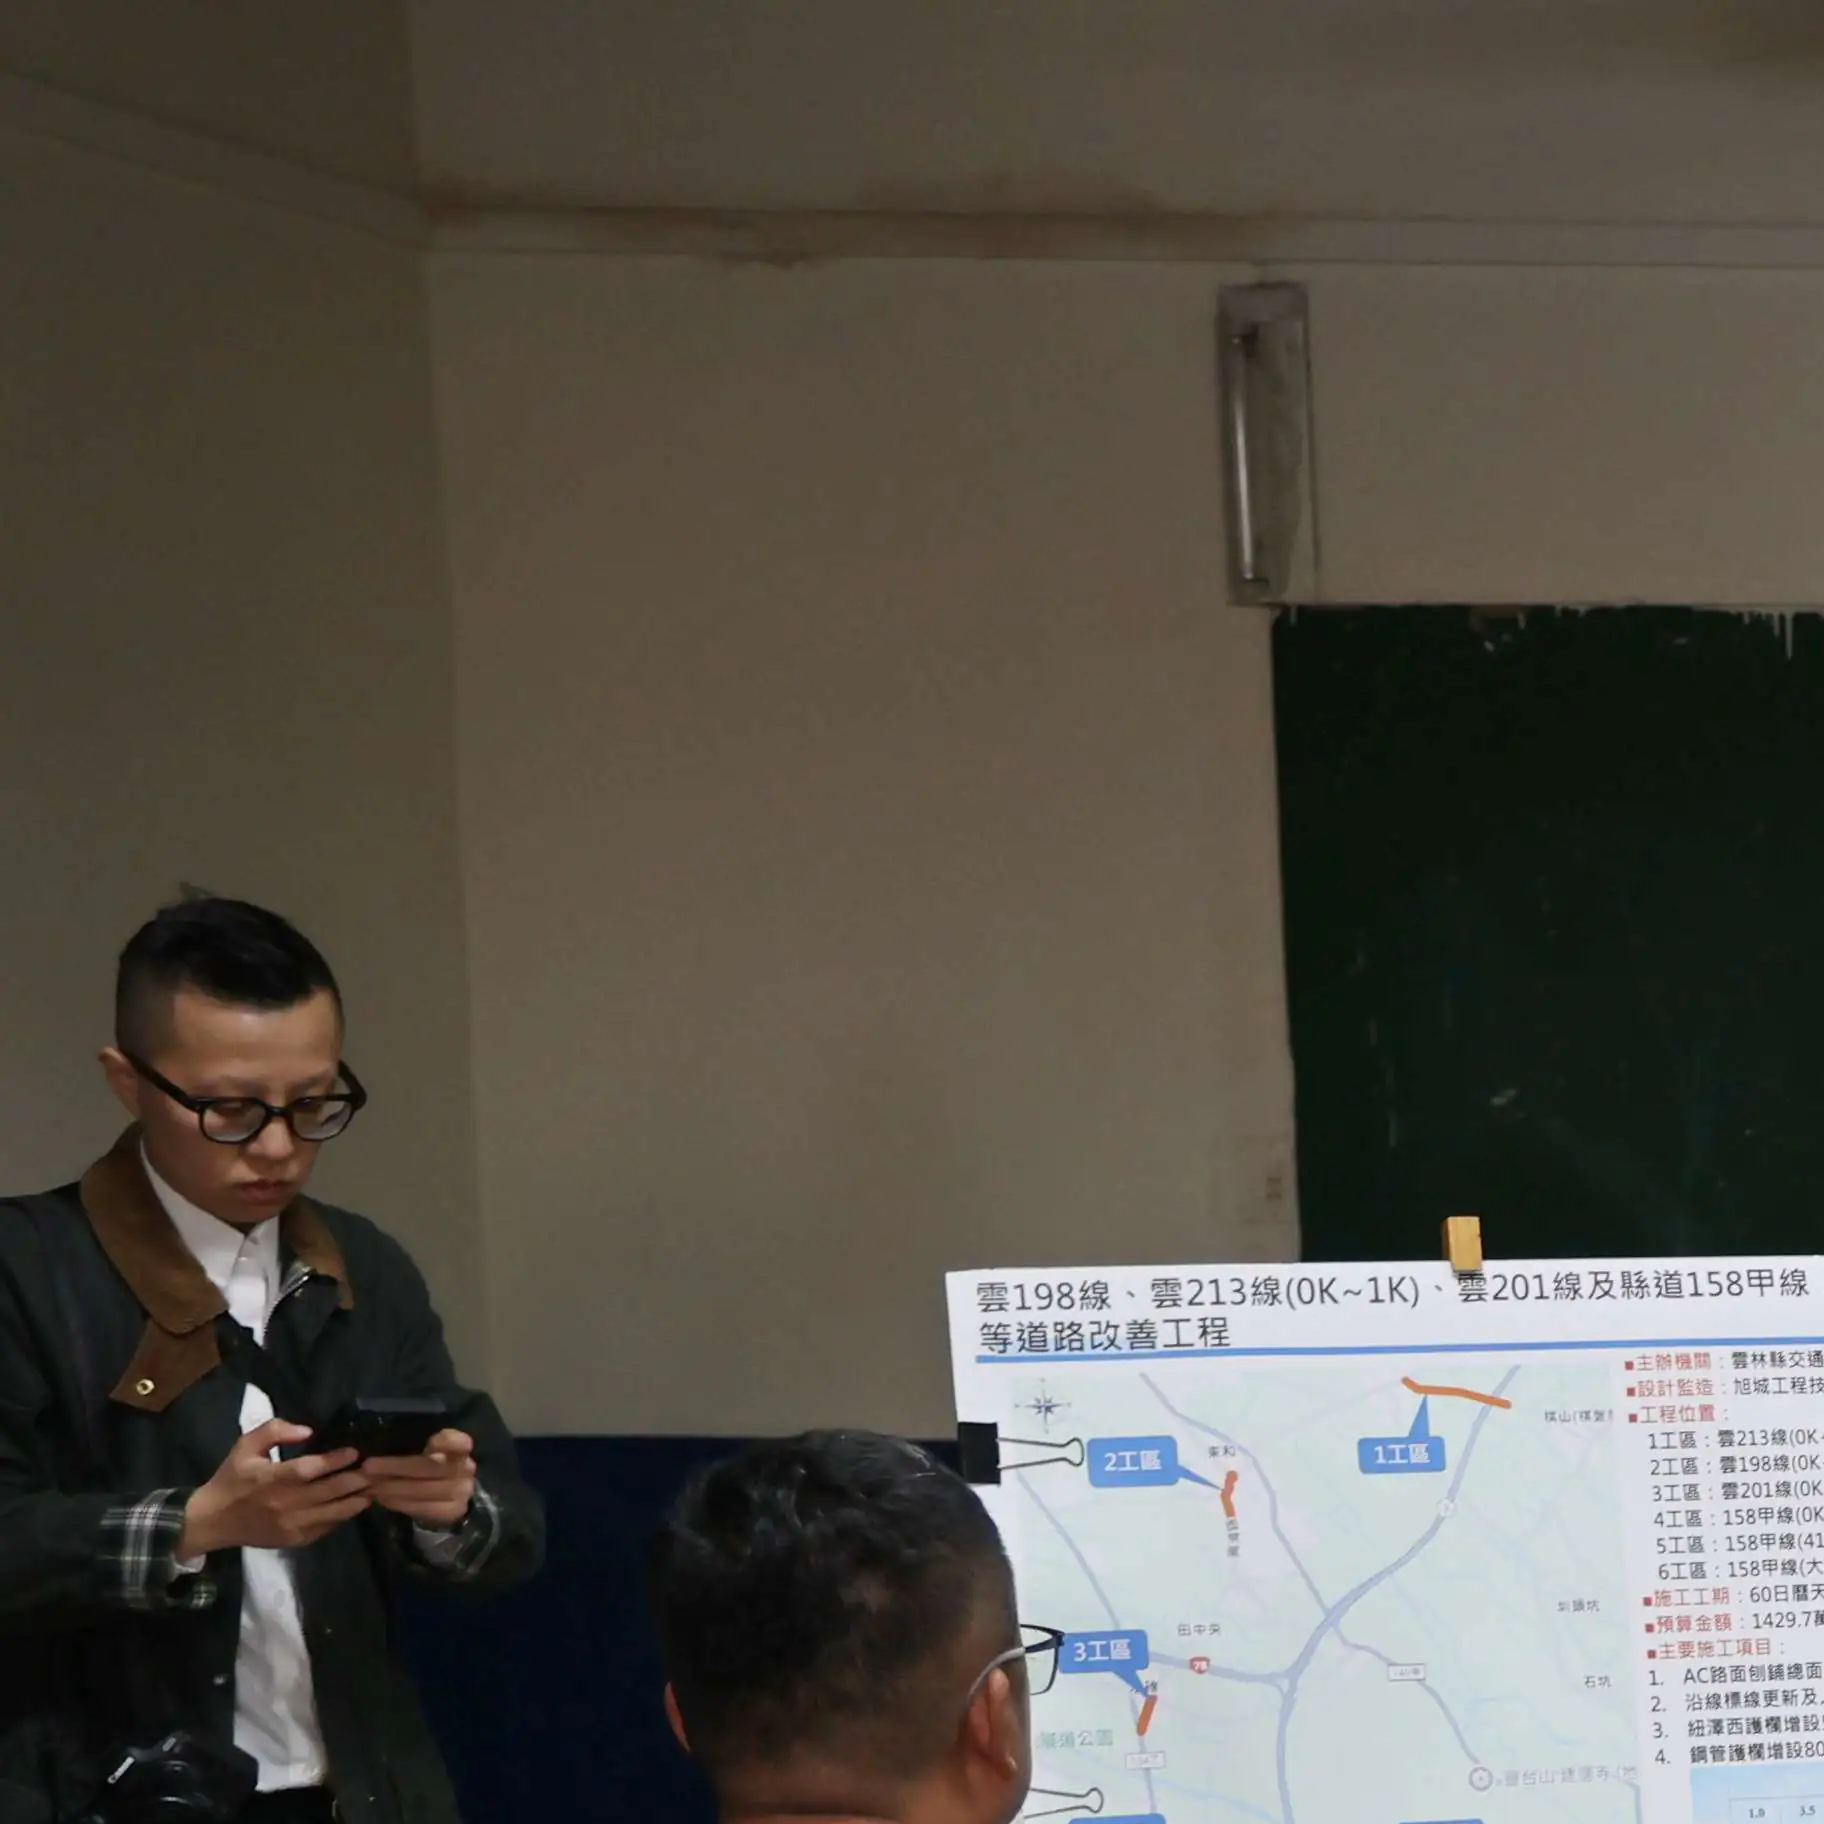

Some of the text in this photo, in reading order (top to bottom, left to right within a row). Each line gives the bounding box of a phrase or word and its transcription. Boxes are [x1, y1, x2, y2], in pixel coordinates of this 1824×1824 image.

[976, 1268, 1810, 1313] 雲198線、雲213線(0K~1K)、雲201線及縣道158甲線
[979, 1316, 1231, 1354] 等道路改善工程
[1104, 1450, 1162, 1473] 2工區
[1373, 1443, 1431, 1465] 1工區
[1074, 1639, 1132, 1662] 3工區
[1649, 1670, 1665, 1687] 1.
[1651, 1697, 1667, 1713] 2.
[1652, 1723, 1669, 1739] 3.
[1655, 1749, 1671, 1765] 4.
